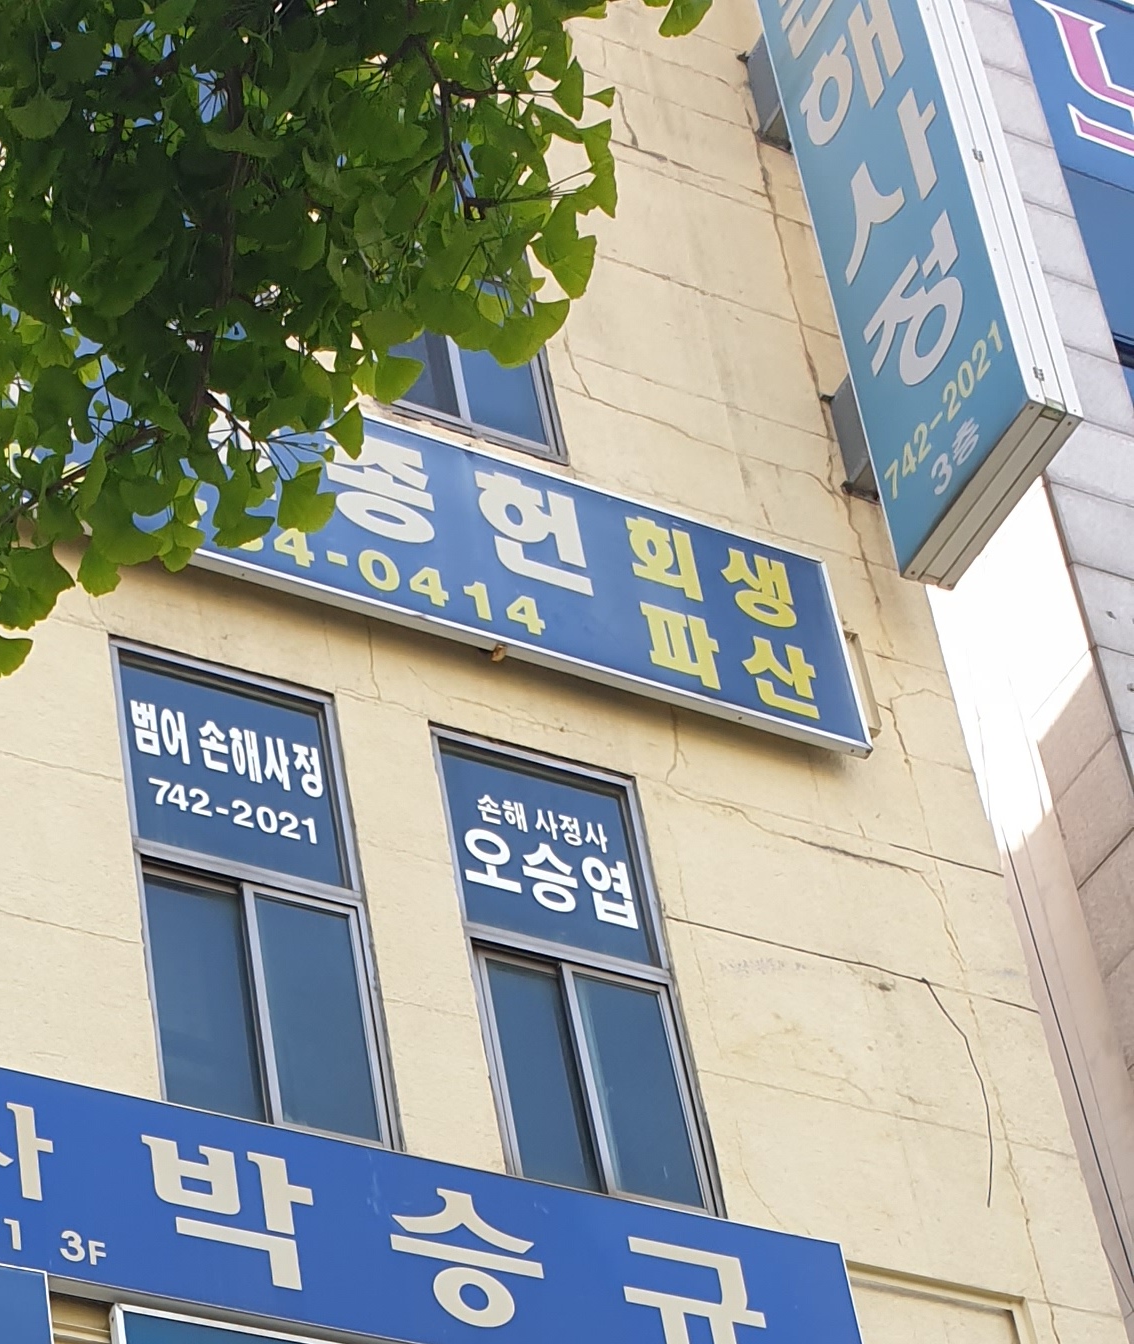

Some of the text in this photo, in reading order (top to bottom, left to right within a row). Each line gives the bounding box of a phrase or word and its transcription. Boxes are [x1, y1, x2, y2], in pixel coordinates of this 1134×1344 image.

[884, 319, 1004, 500] 742-2021
[931, 417, 980, 496] 3층
[625, 516, 798, 629] 회생
[639, 600, 820, 720] 파산
[129, 698, 324, 799] 범어 손해사정
[147, 777, 319, 845] 742-2021
[476, 794, 608, 853] 손해 사정사
[464, 827, 639, 931] 오승엽
[59, 1230, 108, 1266] 3F
